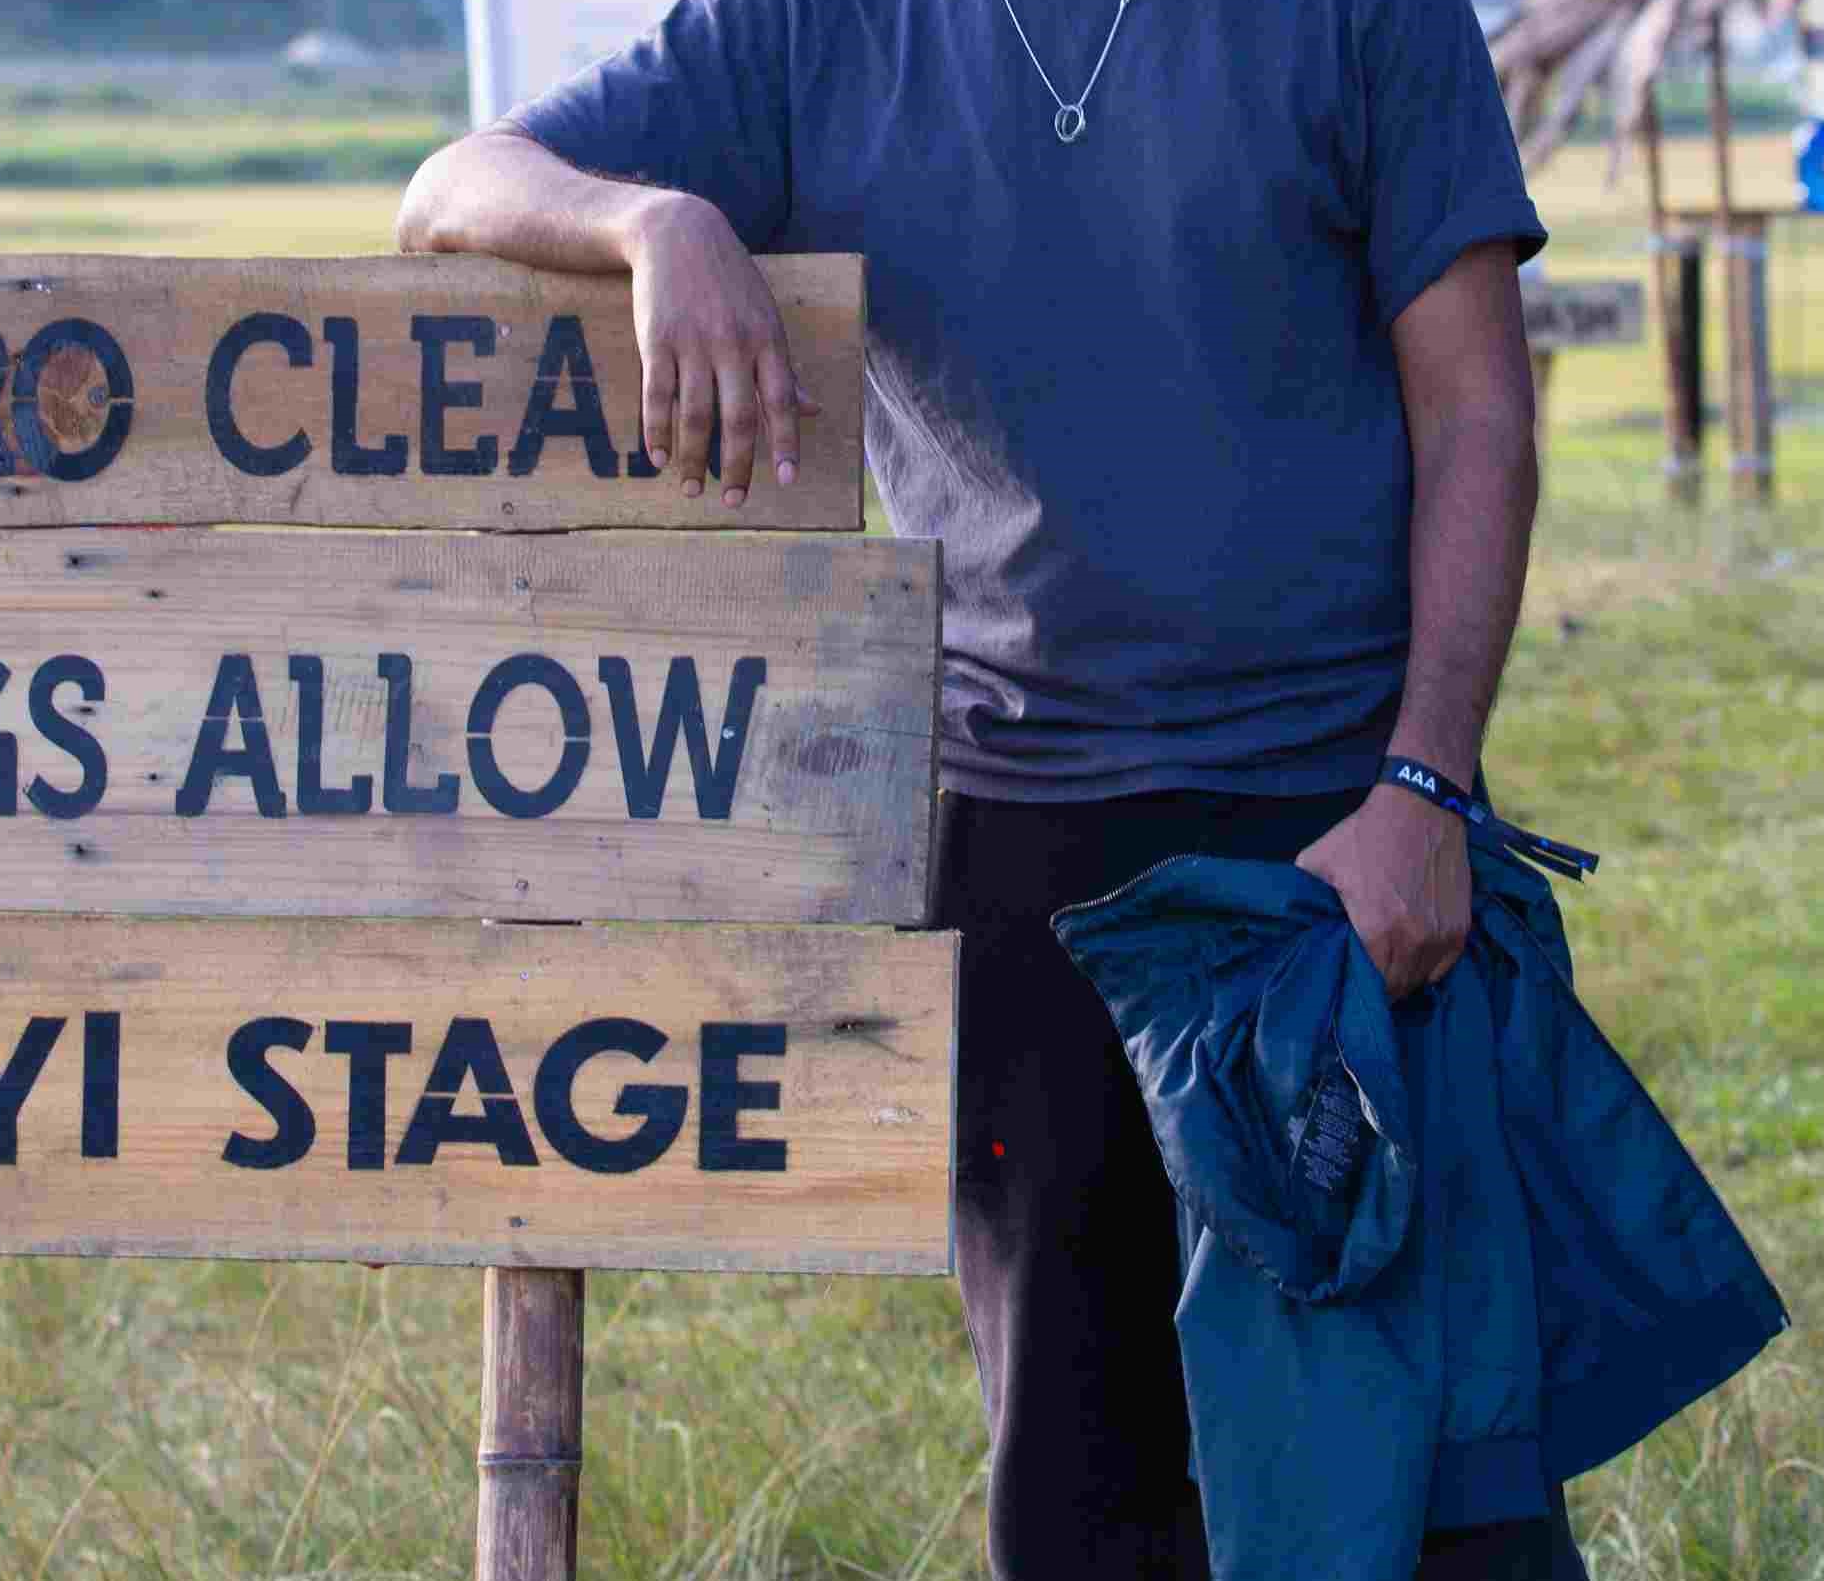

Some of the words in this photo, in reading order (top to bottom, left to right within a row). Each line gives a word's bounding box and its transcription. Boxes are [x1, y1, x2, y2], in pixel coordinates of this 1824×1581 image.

[204, 312, 722, 481] CLEA
[176, 652, 768, 821] ALLOW
[1397, 764, 1437, 794] AAA
[221, 1016, 788, 1174] STAGE
